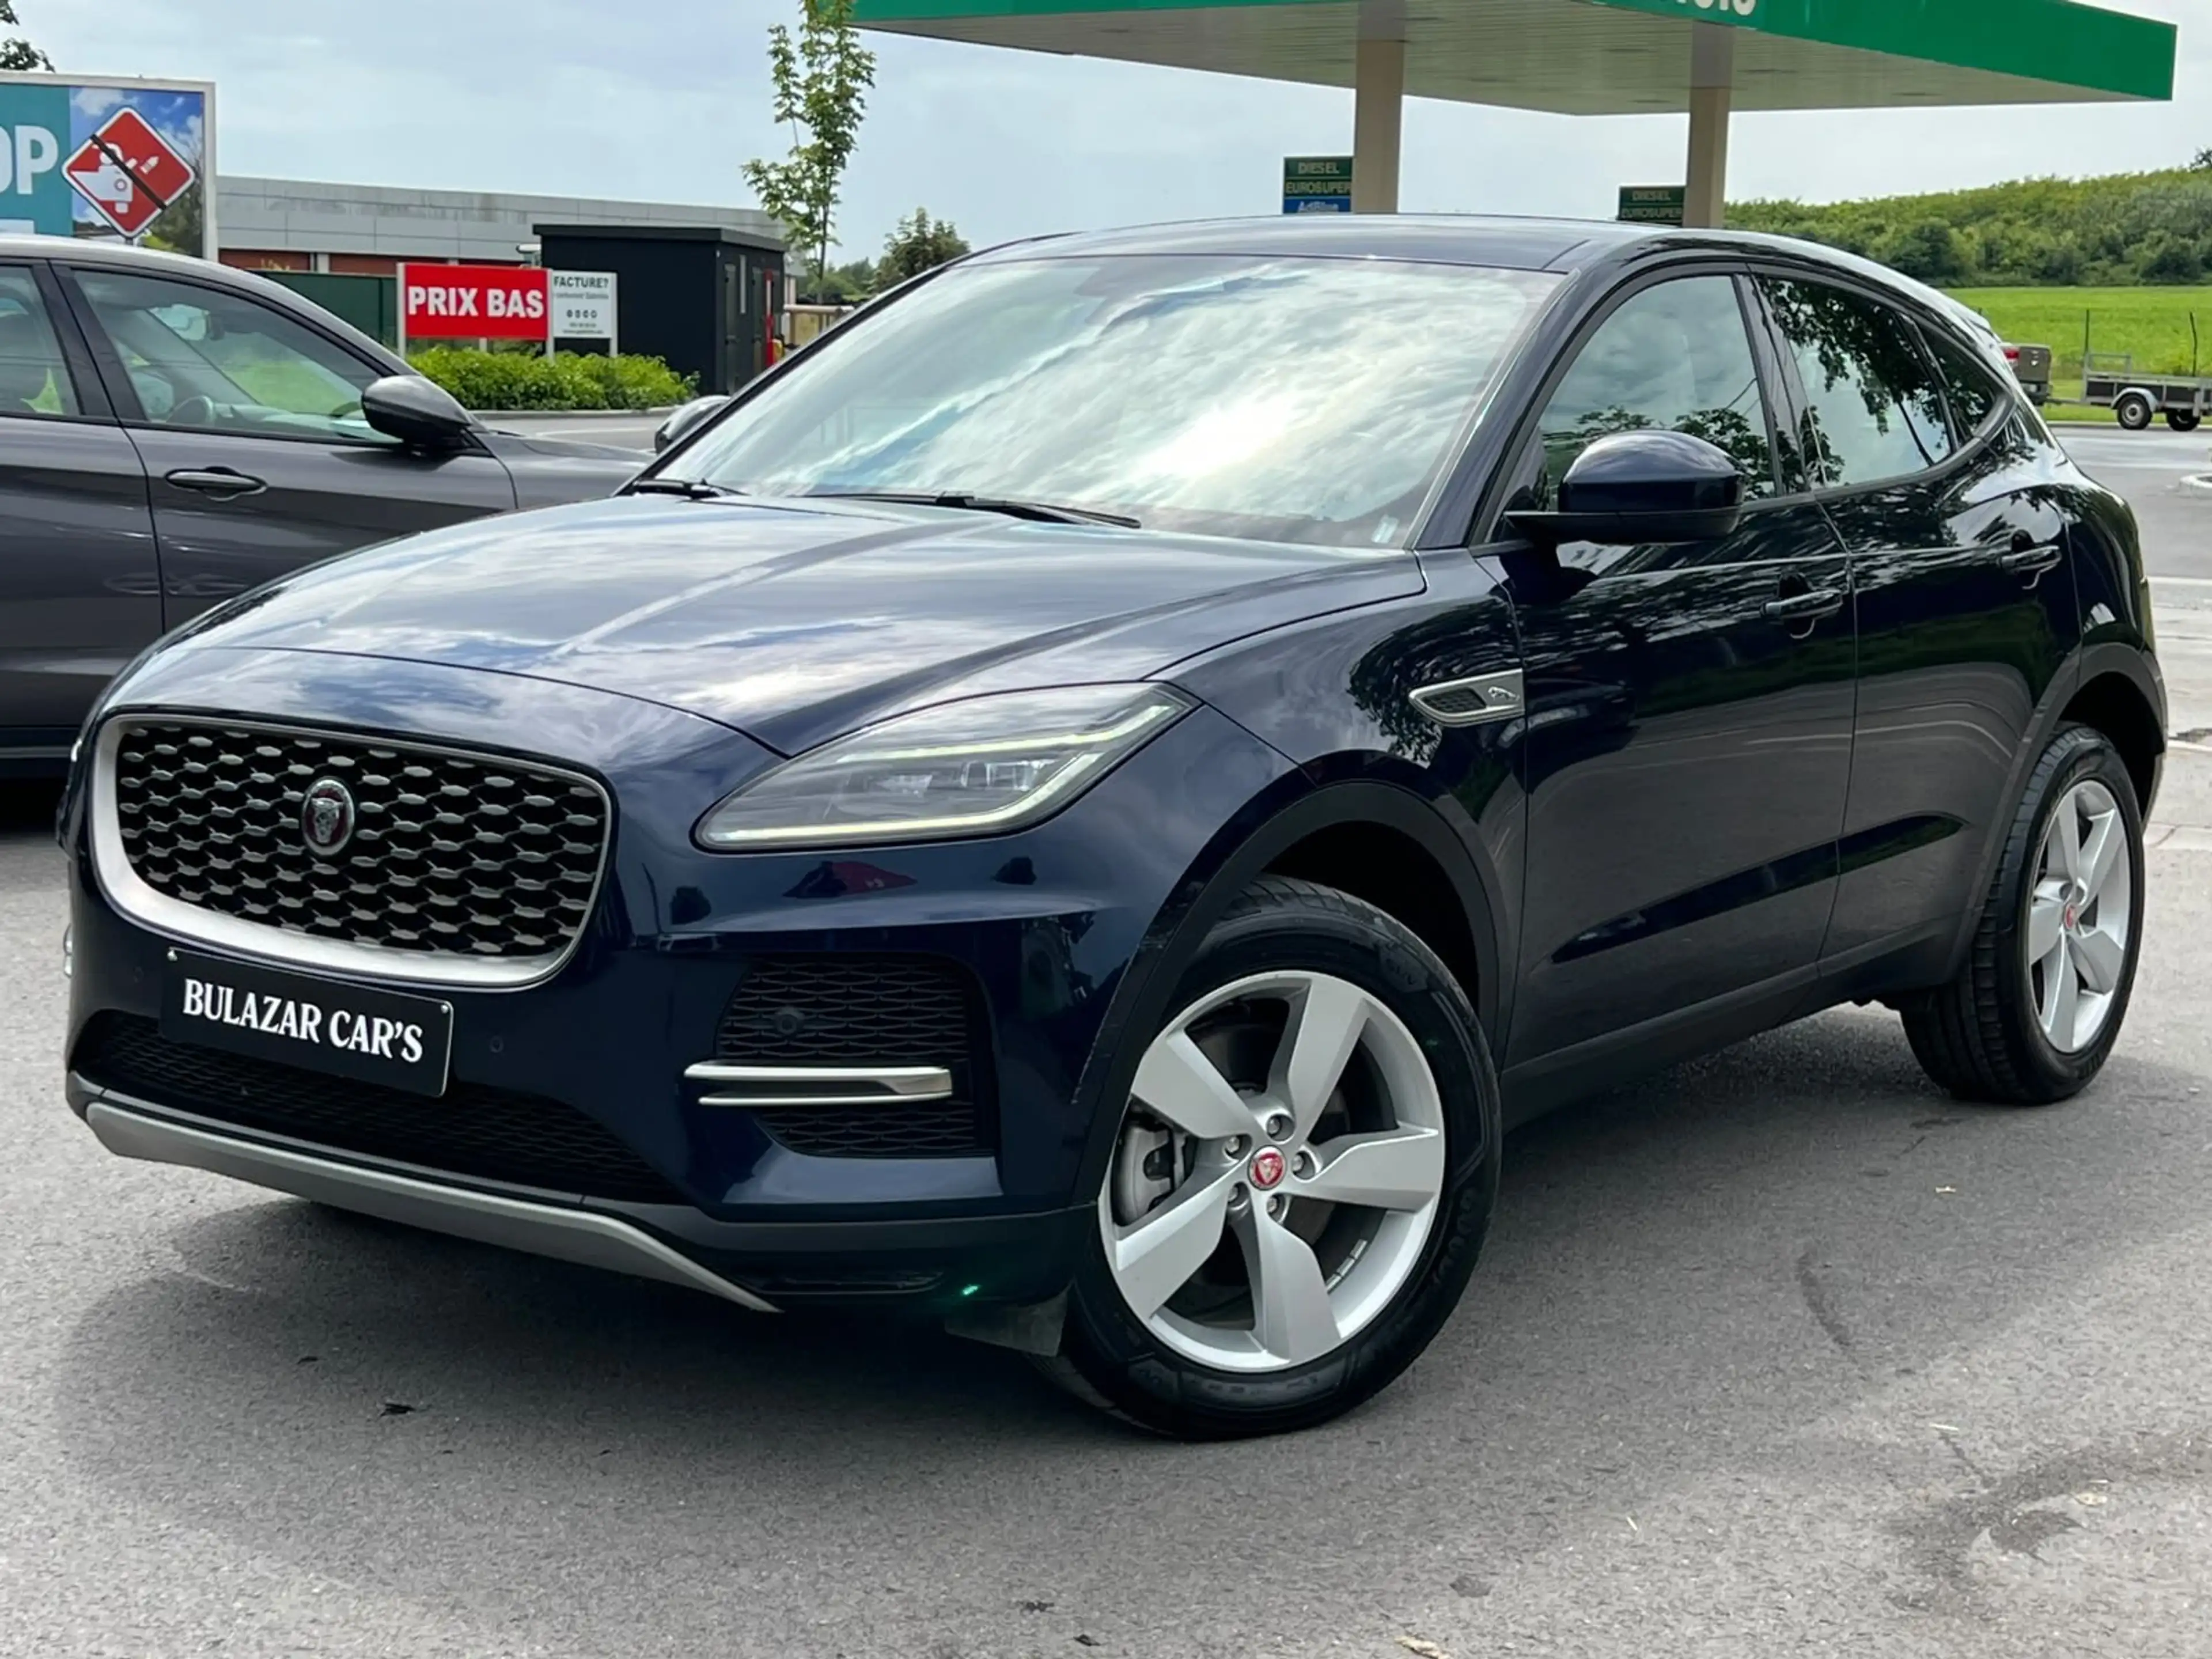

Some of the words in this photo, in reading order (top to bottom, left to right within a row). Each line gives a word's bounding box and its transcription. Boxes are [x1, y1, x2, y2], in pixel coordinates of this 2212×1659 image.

[1297, 161, 1340, 174] DIESEL
[554, 276, 609, 288] FACTURE?
[408, 286, 479, 316] PRIX
[487, 289, 544, 318] BAS
[183, 978, 323, 1043] BULAZAR
[328, 1010, 424, 1063] CAR'S
